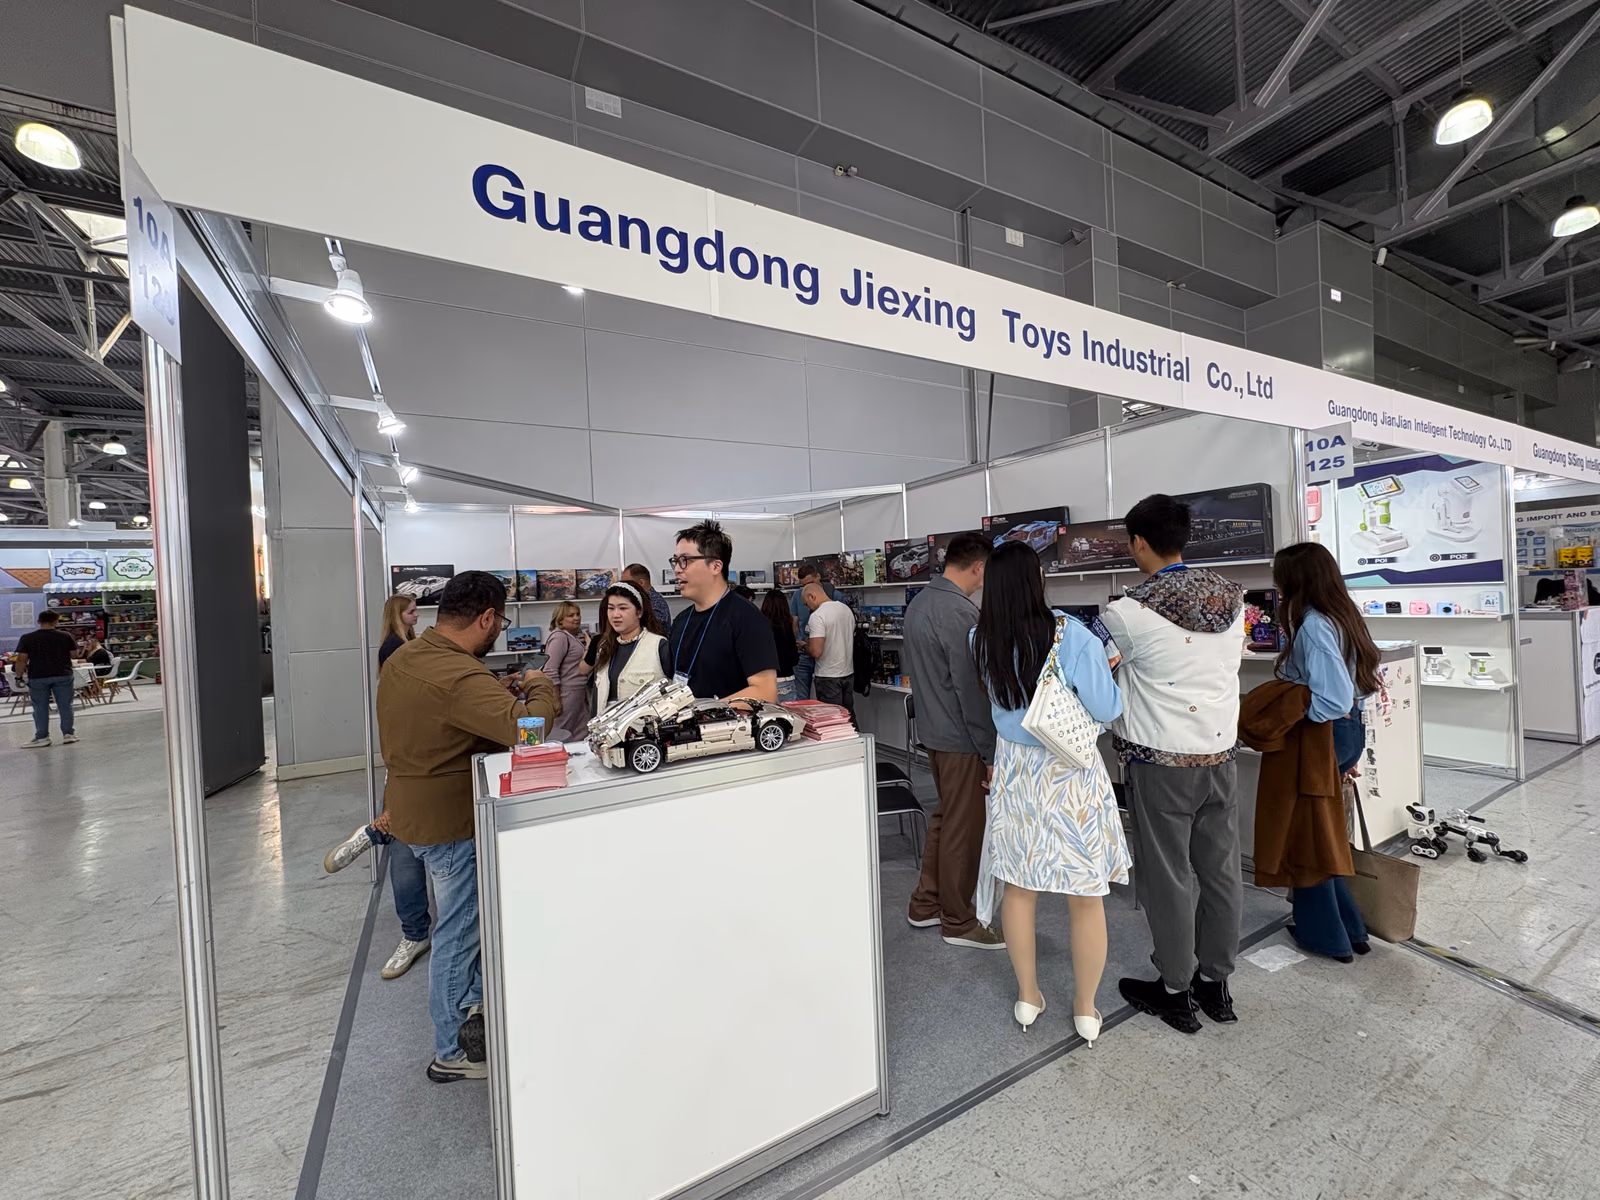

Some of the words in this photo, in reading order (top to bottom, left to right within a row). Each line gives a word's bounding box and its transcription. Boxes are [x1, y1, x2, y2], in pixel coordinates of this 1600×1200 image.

[133, 196, 174, 273] 10A
[472, 164, 819, 305] Guangdong
[840, 268, 976, 342] Jiexing
[1002, 309, 1071, 359] Toys
[1083, 330, 1190, 383] Industrial
[1207, 362, 1274, 400] Co.,Ltd
[1328, 399, 1378, 427] Guangdong
[1380, 411, 1412, 431] JianJian
[1448, 425, 1487, 449] Technology
[1305, 435, 1346, 452] 10A
[1532, 442, 1566, 468] Guangdong
[1306, 455, 1345, 472] 125
[1526, 513, 1563, 522] IMPORT
[1566, 511, 1587, 519] AND
